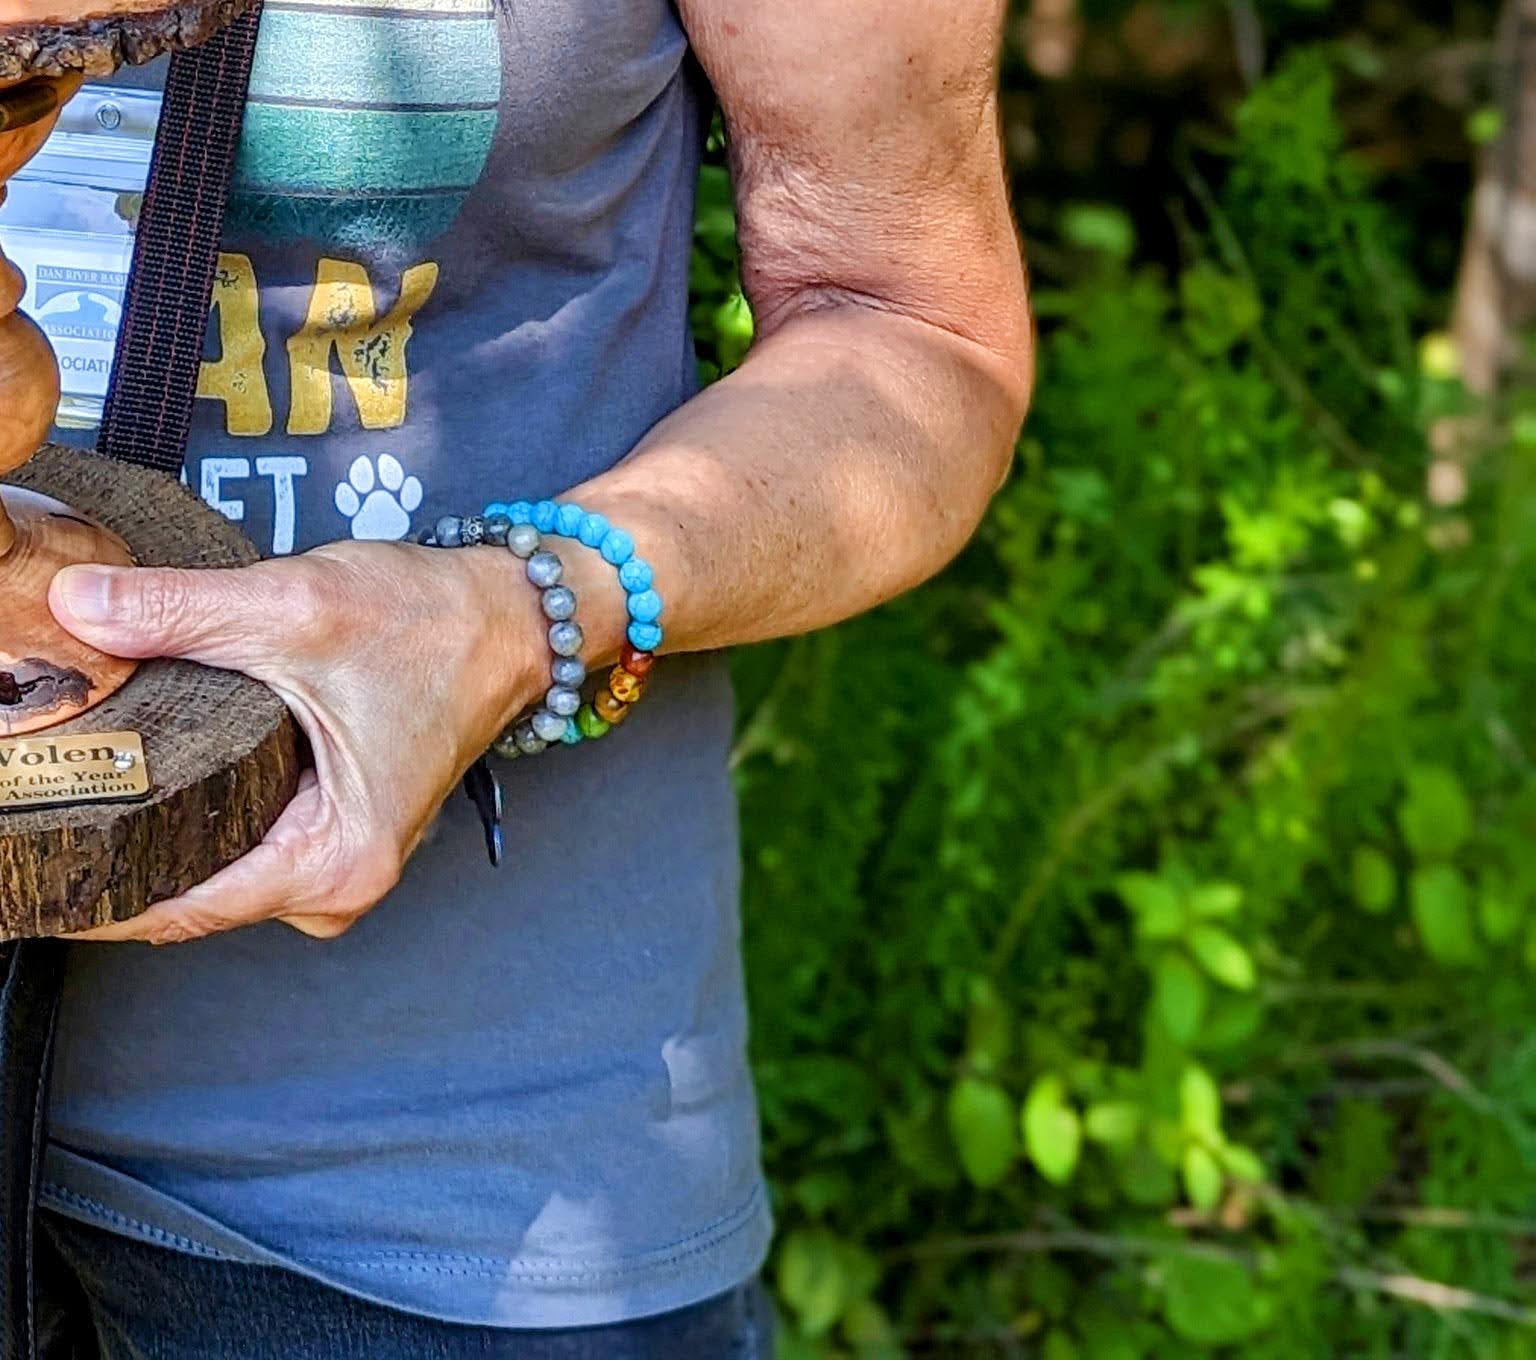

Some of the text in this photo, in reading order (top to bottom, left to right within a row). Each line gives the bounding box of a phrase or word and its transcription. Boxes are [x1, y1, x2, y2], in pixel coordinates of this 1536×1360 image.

[38, 267, 124, 284] DAN RIVER BASI
[60, 355, 109, 373] OCIATI
[180, 456, 307, 554] ET
[0, 775, 24, 787] of
[29, 774, 64, 786] the
[72, 770, 127, 781] Year
[5, 782, 137, 801] Association
